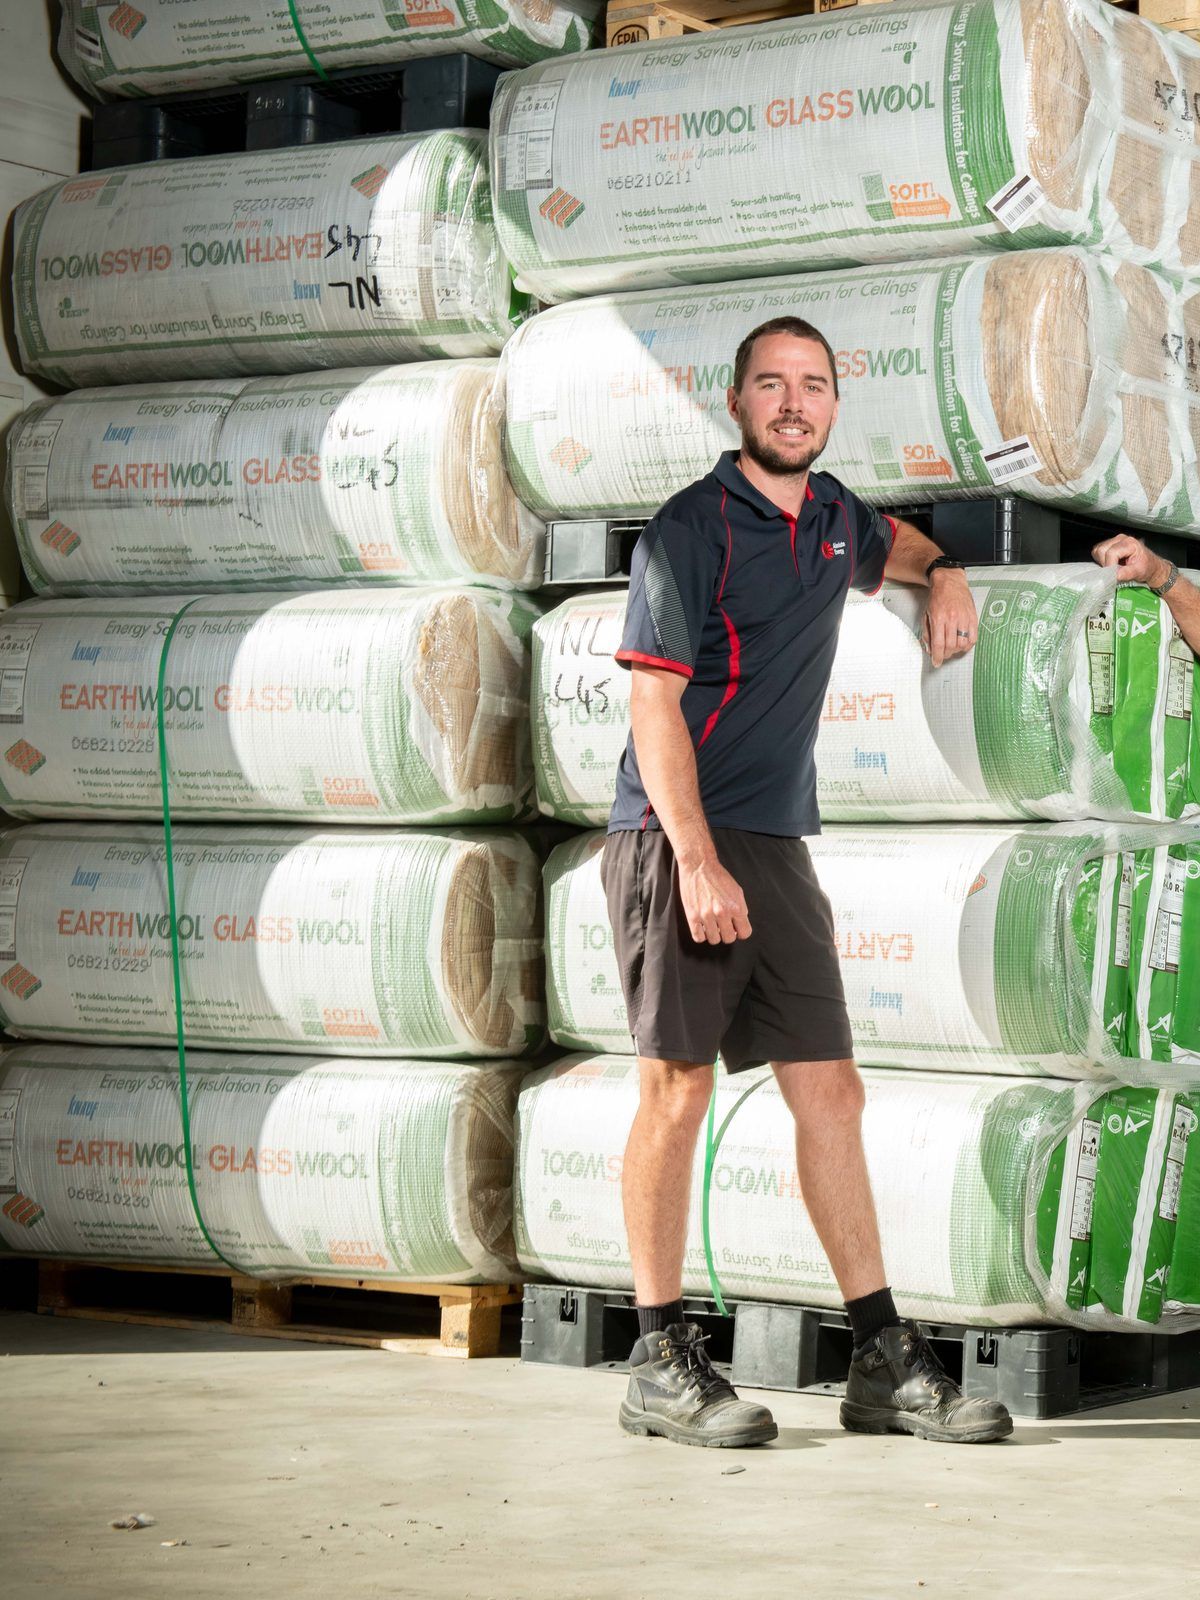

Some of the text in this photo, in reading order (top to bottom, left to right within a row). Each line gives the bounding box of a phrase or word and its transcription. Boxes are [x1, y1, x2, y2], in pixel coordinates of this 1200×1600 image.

[642, 51, 692, 70] Energy
[694, 43, 741, 63] Saving
[746, 33, 815, 54] Insulation
[846, 19, 908, 38] Ceilings
[600, 81, 935, 150] EARTHWOOL GLASSWOOL
[889, 181, 935, 201] SOFT!
[960, 173, 980, 218] Ceilings
[41, 232, 324, 282] EARTHWOOL GLASSWOOL
[328, 274, 382, 310] NL
[655, 300, 705, 320] Energy
[706, 296, 756, 315] Saving
[834, 284, 856, 300] for
[860, 279, 918, 298] Ceilings
[80, 312, 306, 341] Energy Saving Insulation for Ceilings
[137, 399, 230, 419] Energy Saving
[92, 459, 233, 490] EARTHWOOL
[104, 620, 151, 640] Energy
[559, 616, 614, 657] NL
[1088, 621, 1111, 632] R-4.0
[60, 684, 204, 713] EARTHWOOL
[104, 846, 151, 866] Energy
[198, 847, 263, 864] Insulation
[57, 909, 205, 941] EARTHWOOL
[323, 1007, 365, 1025] SOFT!
[99, 1074, 147, 1094] Energy
[196, 1076, 261, 1093] Insulation
[55, 1138, 202, 1170] EARTHWOOL
[1081, 1144, 1098, 1158] R-4.0
[567, 1232, 622, 1258] Ceilings
[722, 1247, 830, 1280] Energy Saving
